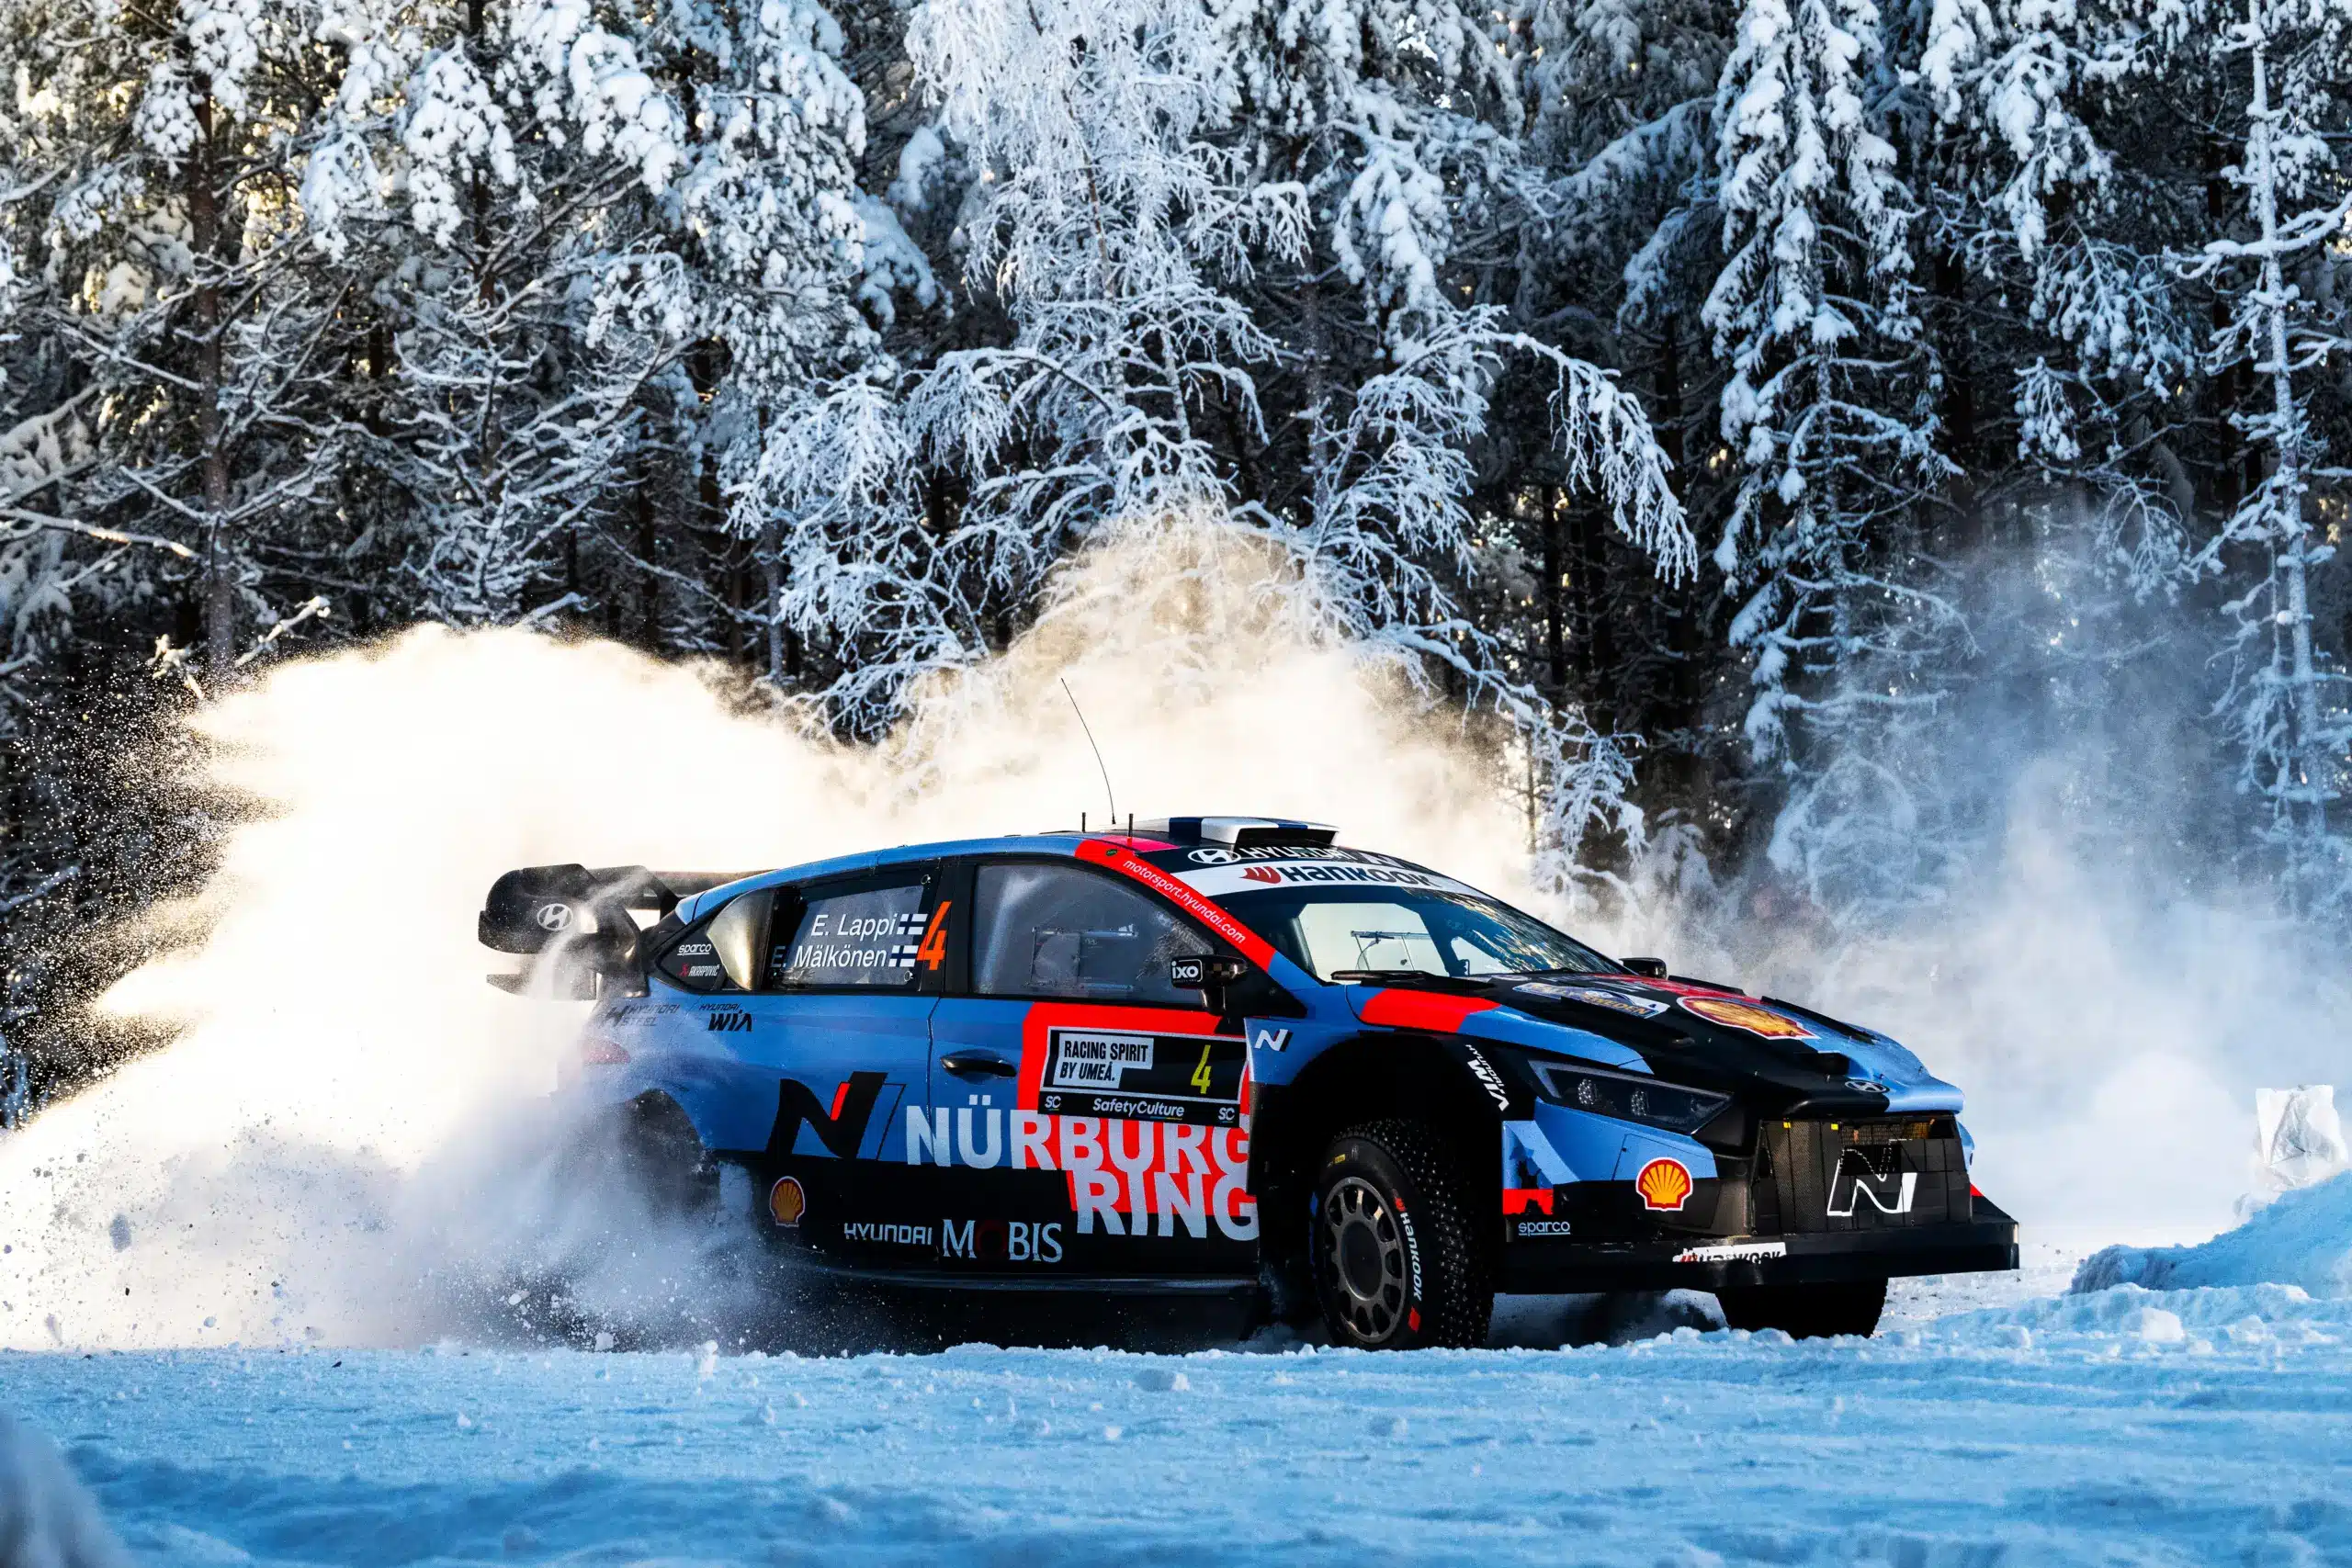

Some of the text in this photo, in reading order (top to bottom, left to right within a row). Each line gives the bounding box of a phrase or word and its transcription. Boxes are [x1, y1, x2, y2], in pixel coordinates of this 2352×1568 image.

[1239, 847, 1358, 861] HYUNDAI
[1123, 859, 1246, 943] motorsport.hyundai.com
[811, 913, 898, 942] E. Lappi
[916, 900, 952, 970] 4
[677, 943, 712, 956] sparco
[771, 944, 888, 968] E. Mälkönen
[708, 1010, 752, 1032] WIA
[1064, 1040, 1148, 1063] RACING SPIRIT
[1059, 1061, 1115, 1082] BY UMEÅ.
[1191, 1044, 1211, 1094] 4
[1045, 1095, 1061, 1109] SC
[1093, 1098, 1184, 1117] SafetyCulture
[1218, 1107, 1235, 1121] SC
[906, 1095, 1250, 1177] NÜRBURG
[1075, 1170, 1260, 1242] RING
[1518, 1221, 1571, 1236] sparco
[843, 1219, 1062, 1263] HYUNDAI MOBIS
